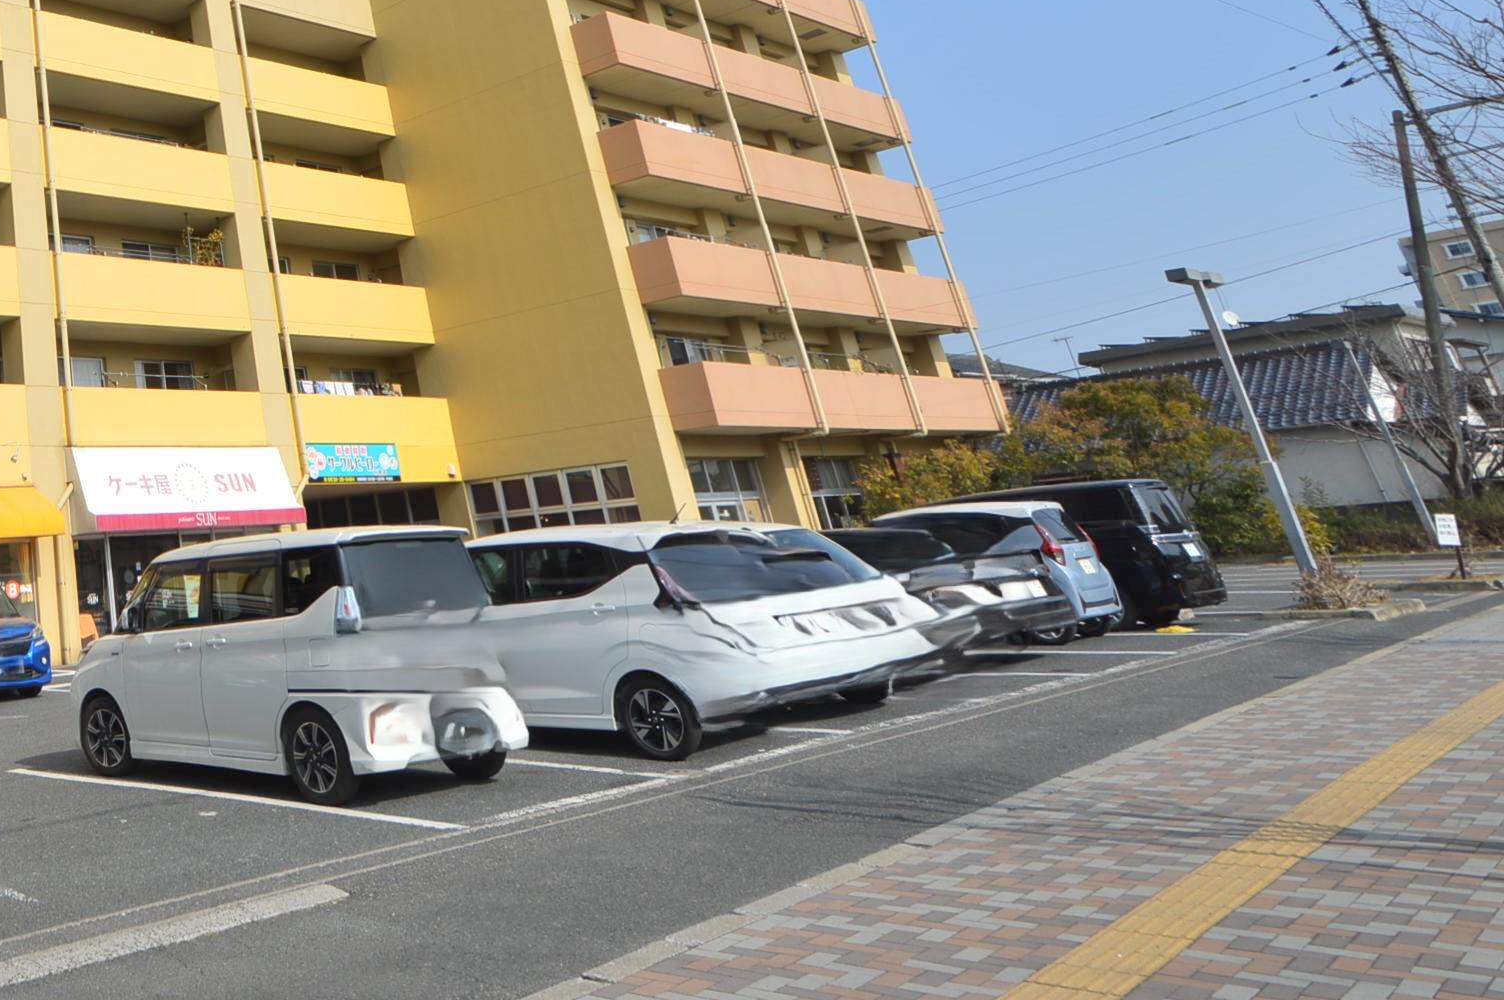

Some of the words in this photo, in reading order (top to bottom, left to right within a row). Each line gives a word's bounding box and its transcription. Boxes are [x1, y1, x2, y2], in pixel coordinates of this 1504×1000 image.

[108, 474, 173, 496] ケーキ屋
[214, 472, 257, 493] SUN
[196, 512, 217, 527] SUN
